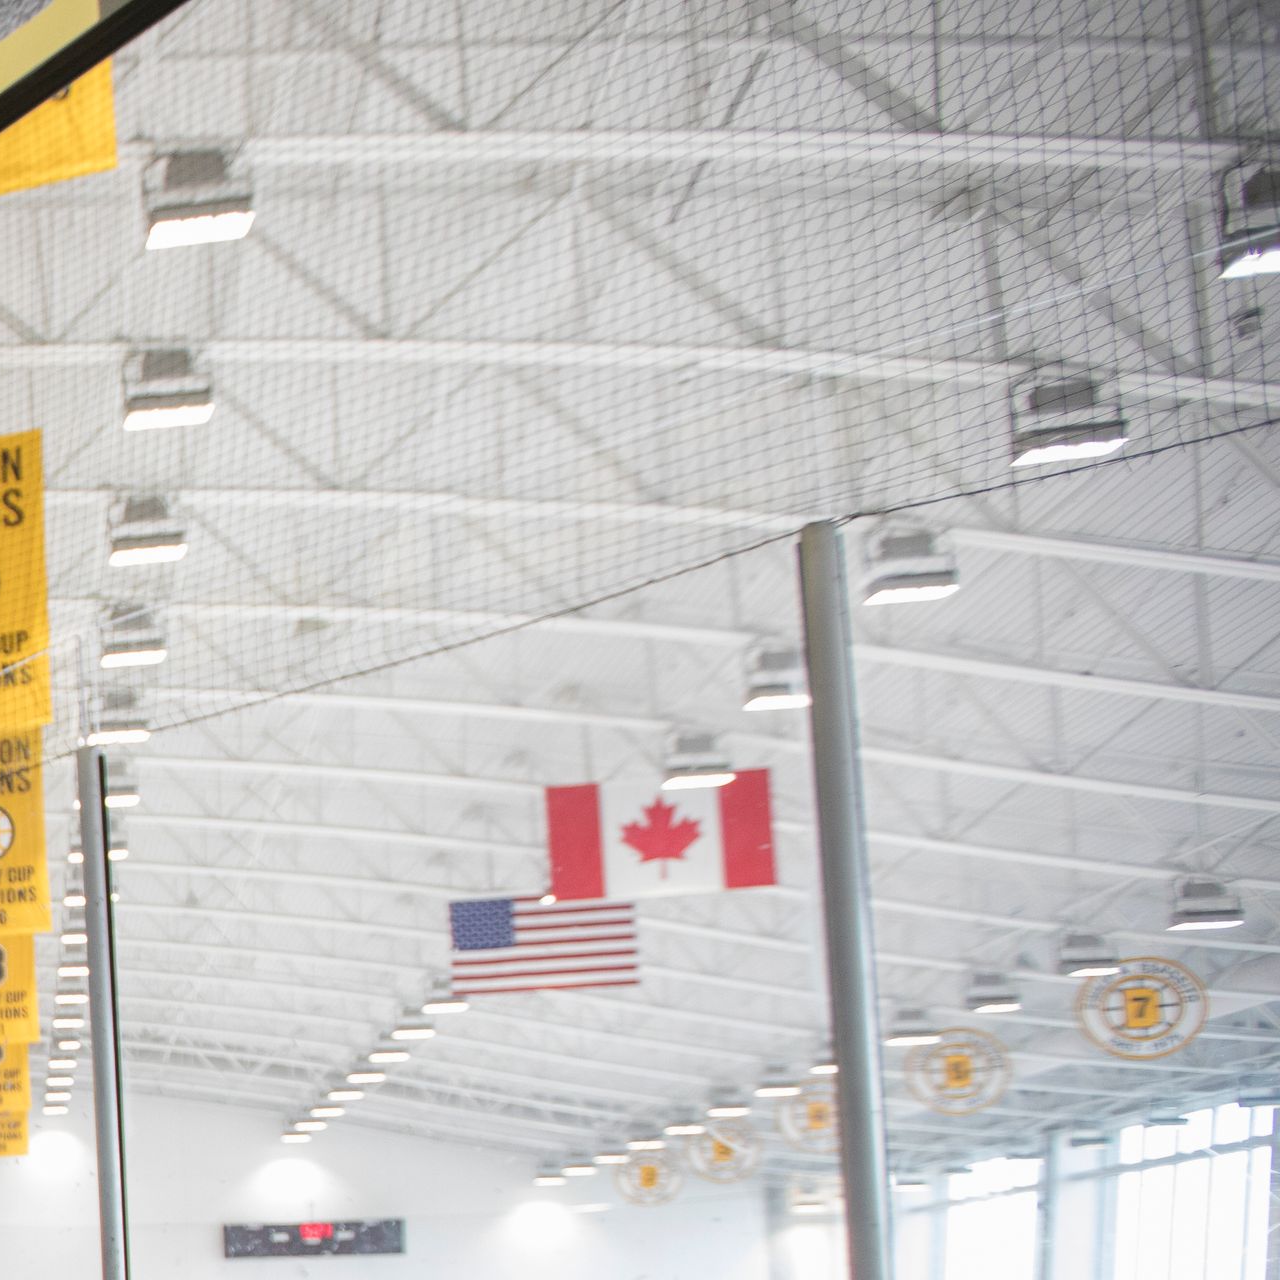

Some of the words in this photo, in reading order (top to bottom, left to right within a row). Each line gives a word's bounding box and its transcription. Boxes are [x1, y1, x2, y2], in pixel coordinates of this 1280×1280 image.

[8, 864, 35, 883] CUP
[6, 989, 28, 1003] CUP
[1131, 996, 1153, 1019] 7
